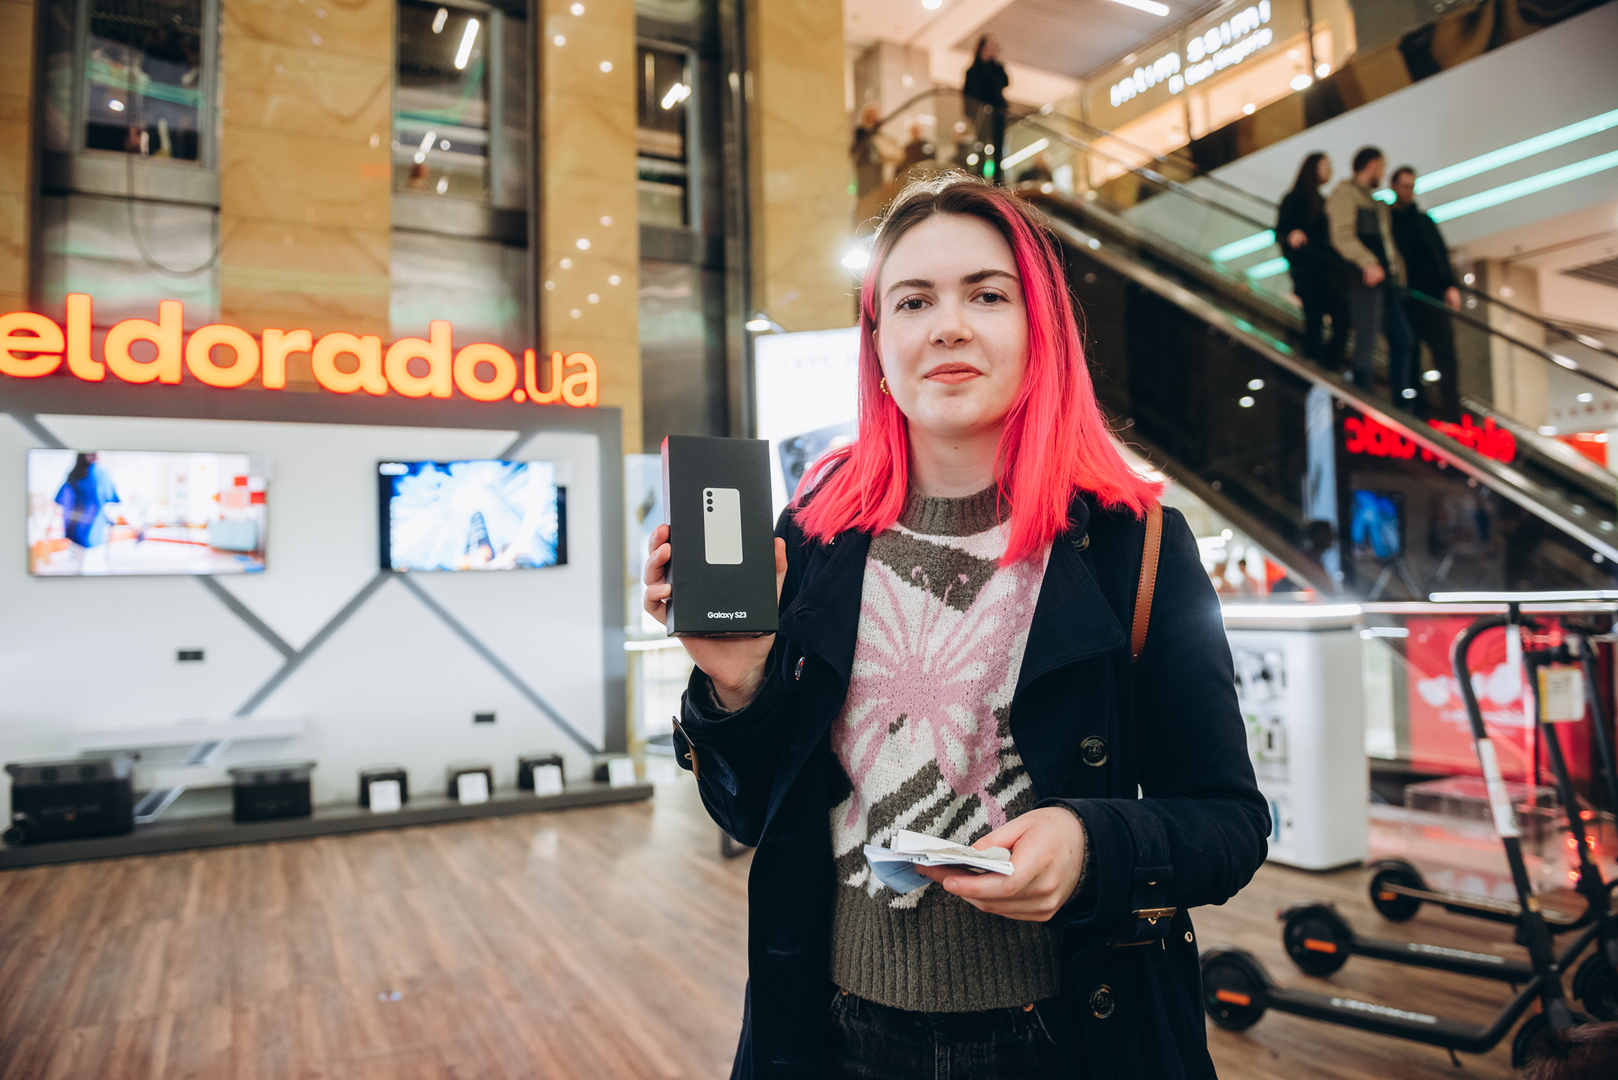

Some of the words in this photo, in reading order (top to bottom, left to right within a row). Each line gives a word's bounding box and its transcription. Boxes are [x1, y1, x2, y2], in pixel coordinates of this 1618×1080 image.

[0, 293, 598, 408] eldorado.ua
[707, 611, 734, 620] Galaxy
[734, 611, 747, 619] S23
